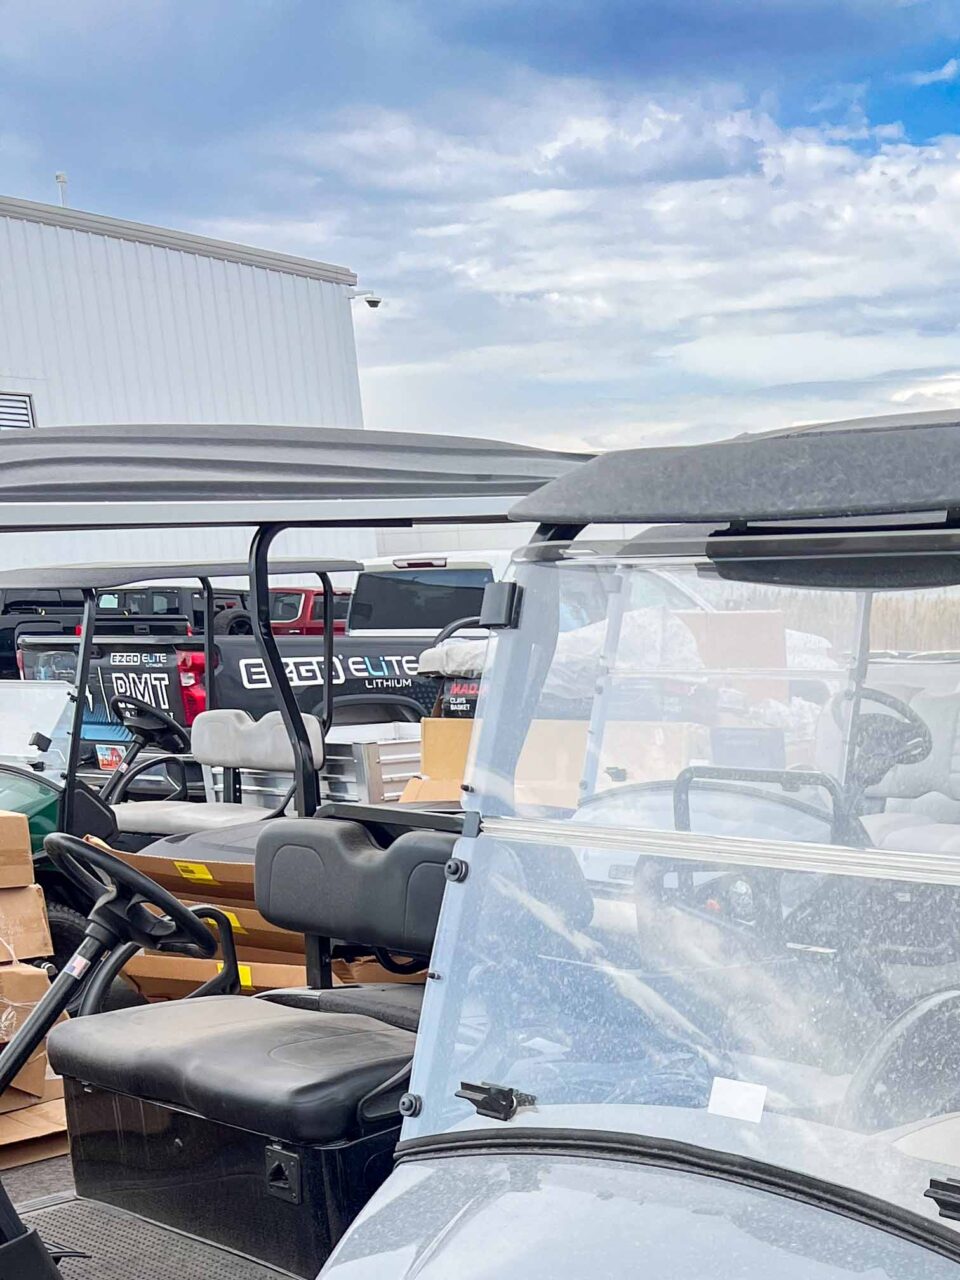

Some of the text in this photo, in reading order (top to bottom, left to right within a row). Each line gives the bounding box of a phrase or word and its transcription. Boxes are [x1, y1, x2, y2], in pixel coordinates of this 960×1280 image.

[111, 653, 139, 665] EZGO
[242, 659, 341, 687] EGO
[365, 679, 412, 688] LITHIUM
